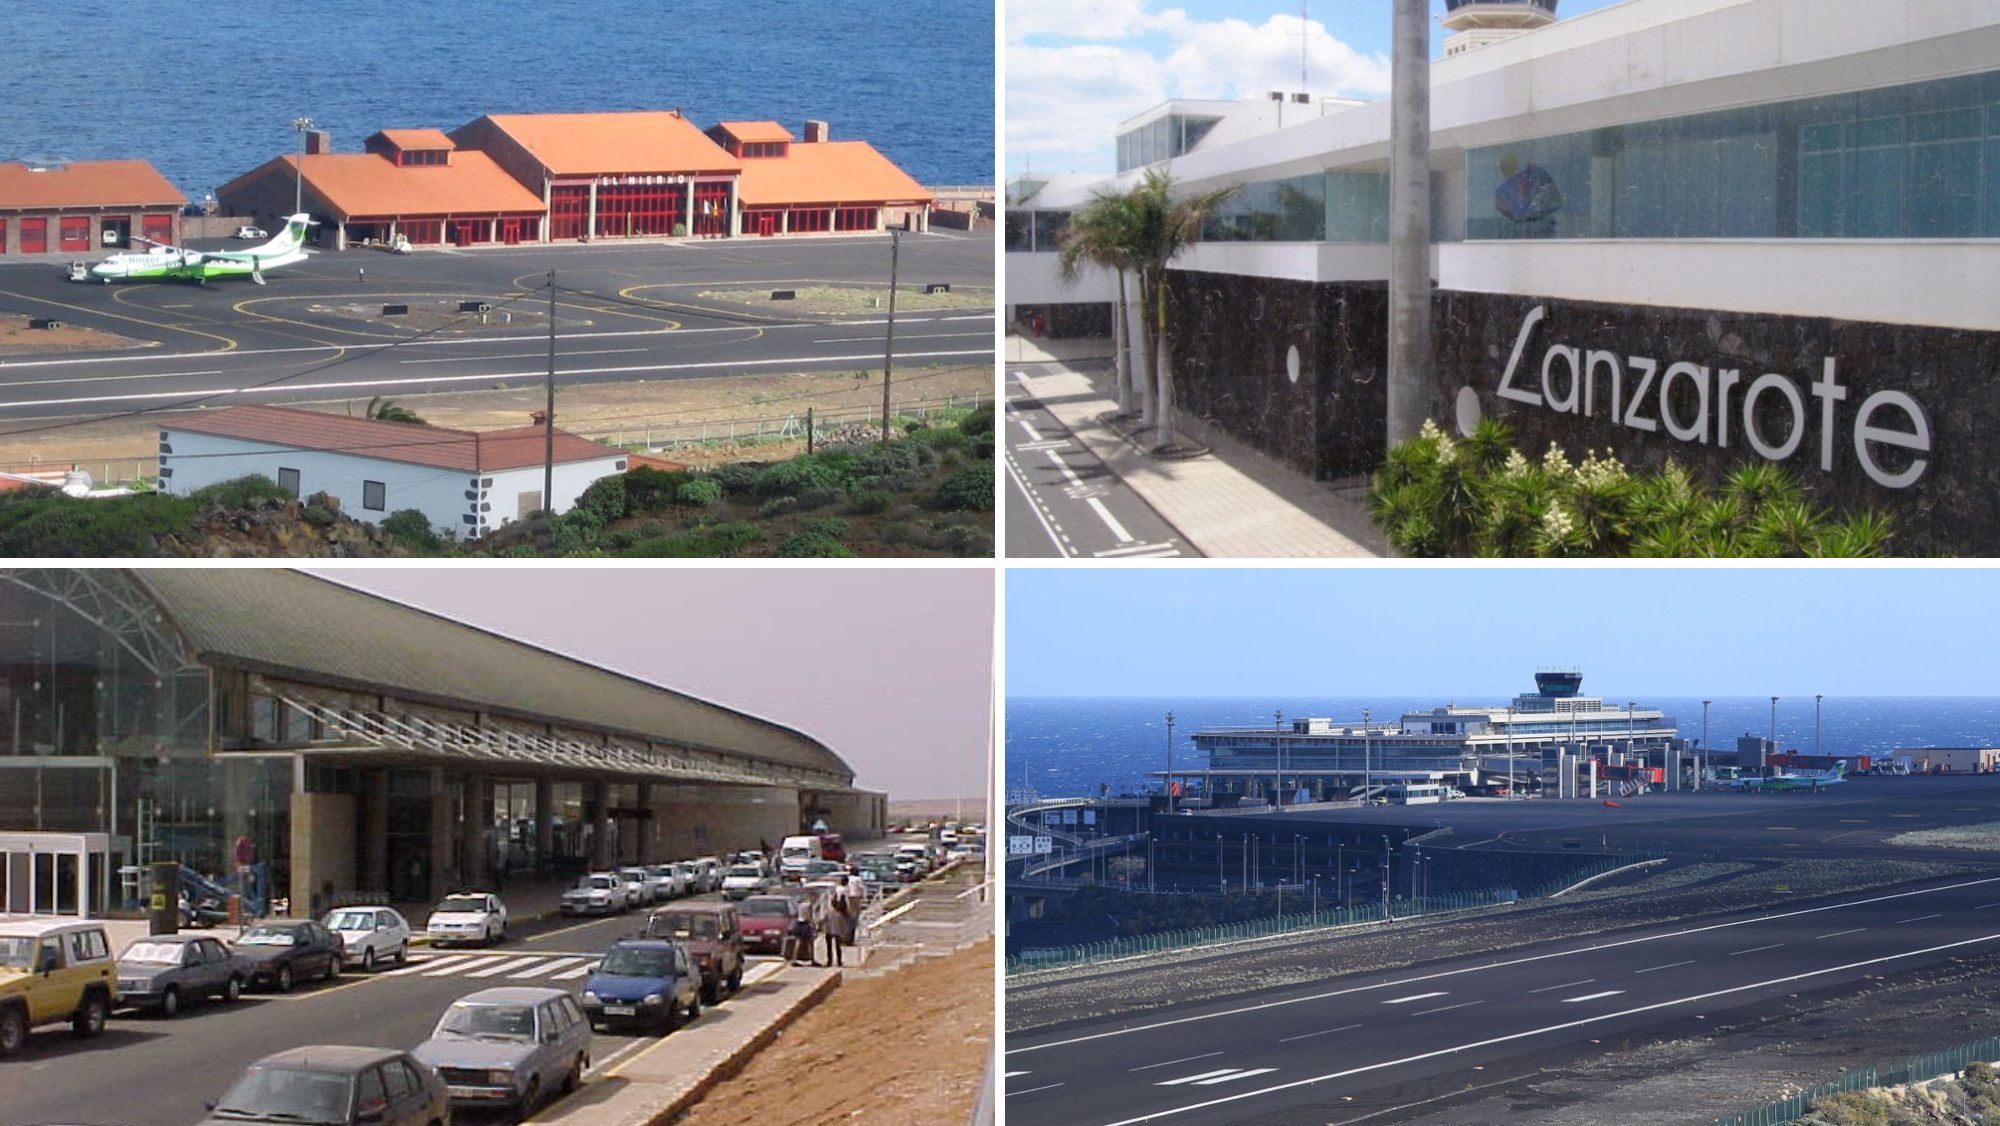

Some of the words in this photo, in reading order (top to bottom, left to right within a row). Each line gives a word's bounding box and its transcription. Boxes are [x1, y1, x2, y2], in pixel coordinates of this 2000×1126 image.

[603, 176, 619, 185] EL
[628, 175, 685, 185] HIERRO
[1496, 304, 1933, 488] Lanzarote
